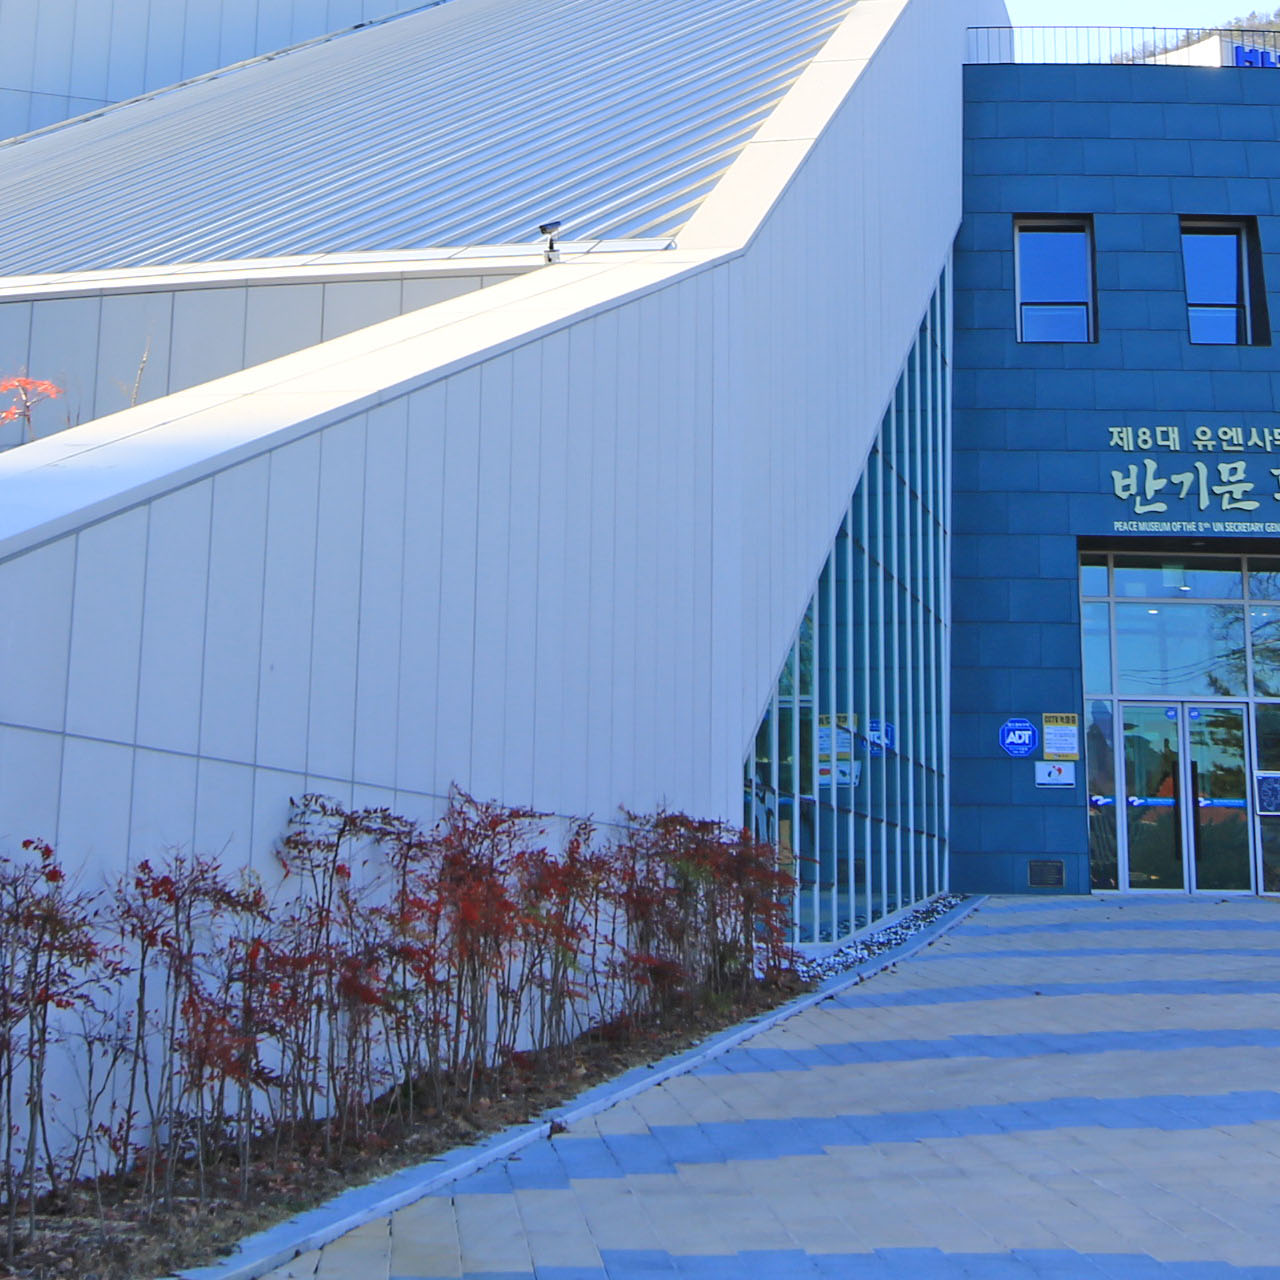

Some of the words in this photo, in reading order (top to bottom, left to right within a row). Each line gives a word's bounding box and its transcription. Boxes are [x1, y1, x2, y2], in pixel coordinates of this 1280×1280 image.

[1109, 425, 1180, 452] 제8대
[1111, 458, 1261, 516] 반기문
[1113, 521, 1137, 531] PEACE
[1138, 521, 1170, 532] MUSEUM
[1171, 521, 1182, 532] OF
[1182, 521, 1197, 532] THE
[1212, 522, 1224, 532] UN
[1224, 522, 1265, 532] SECRETARY
[1005, 730, 1032, 744] ADT
